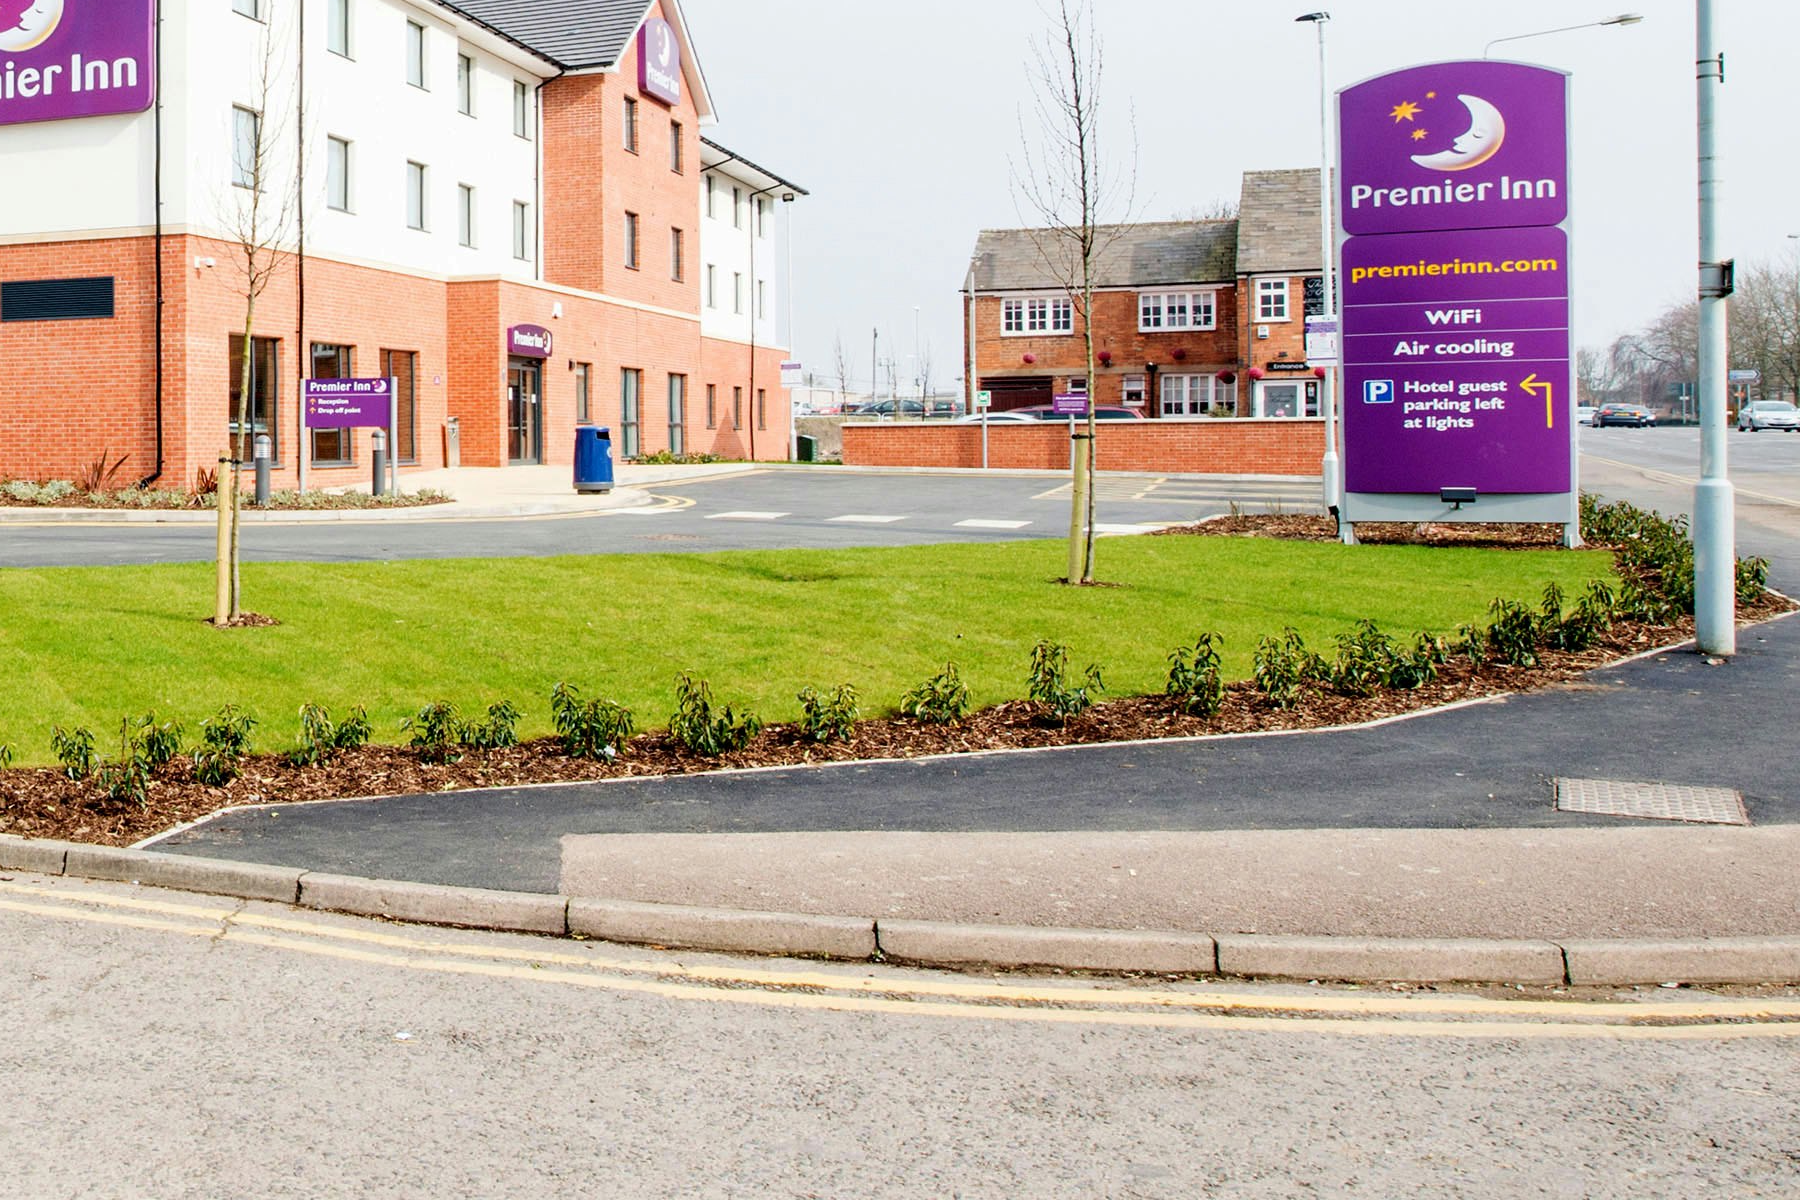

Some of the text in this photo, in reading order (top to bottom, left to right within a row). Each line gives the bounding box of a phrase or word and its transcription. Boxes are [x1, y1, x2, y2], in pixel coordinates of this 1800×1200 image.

[71, 53, 137, 92] Inn
[647, 61, 669, 89] Premier
[1351, 176, 1556, 208] Premier Inn
[1351, 258, 1558, 283] premierinn.com
[1425, 309, 1482, 325] WiFi
[514, 330, 534, 347] Premier
[1393, 339, 1515, 357] Air cooling
[310, 381, 371, 392] Premier Inn
[1369, 383, 1388, 401] P
[1404, 380, 1508, 396] Hotel guest
[318, 398, 349, 406] Reception
[1404, 397, 1505, 414] parking left
[318, 407, 334, 415] Drop
[344, 407, 361, 415] point
[1404, 416, 1474, 432] at lights
